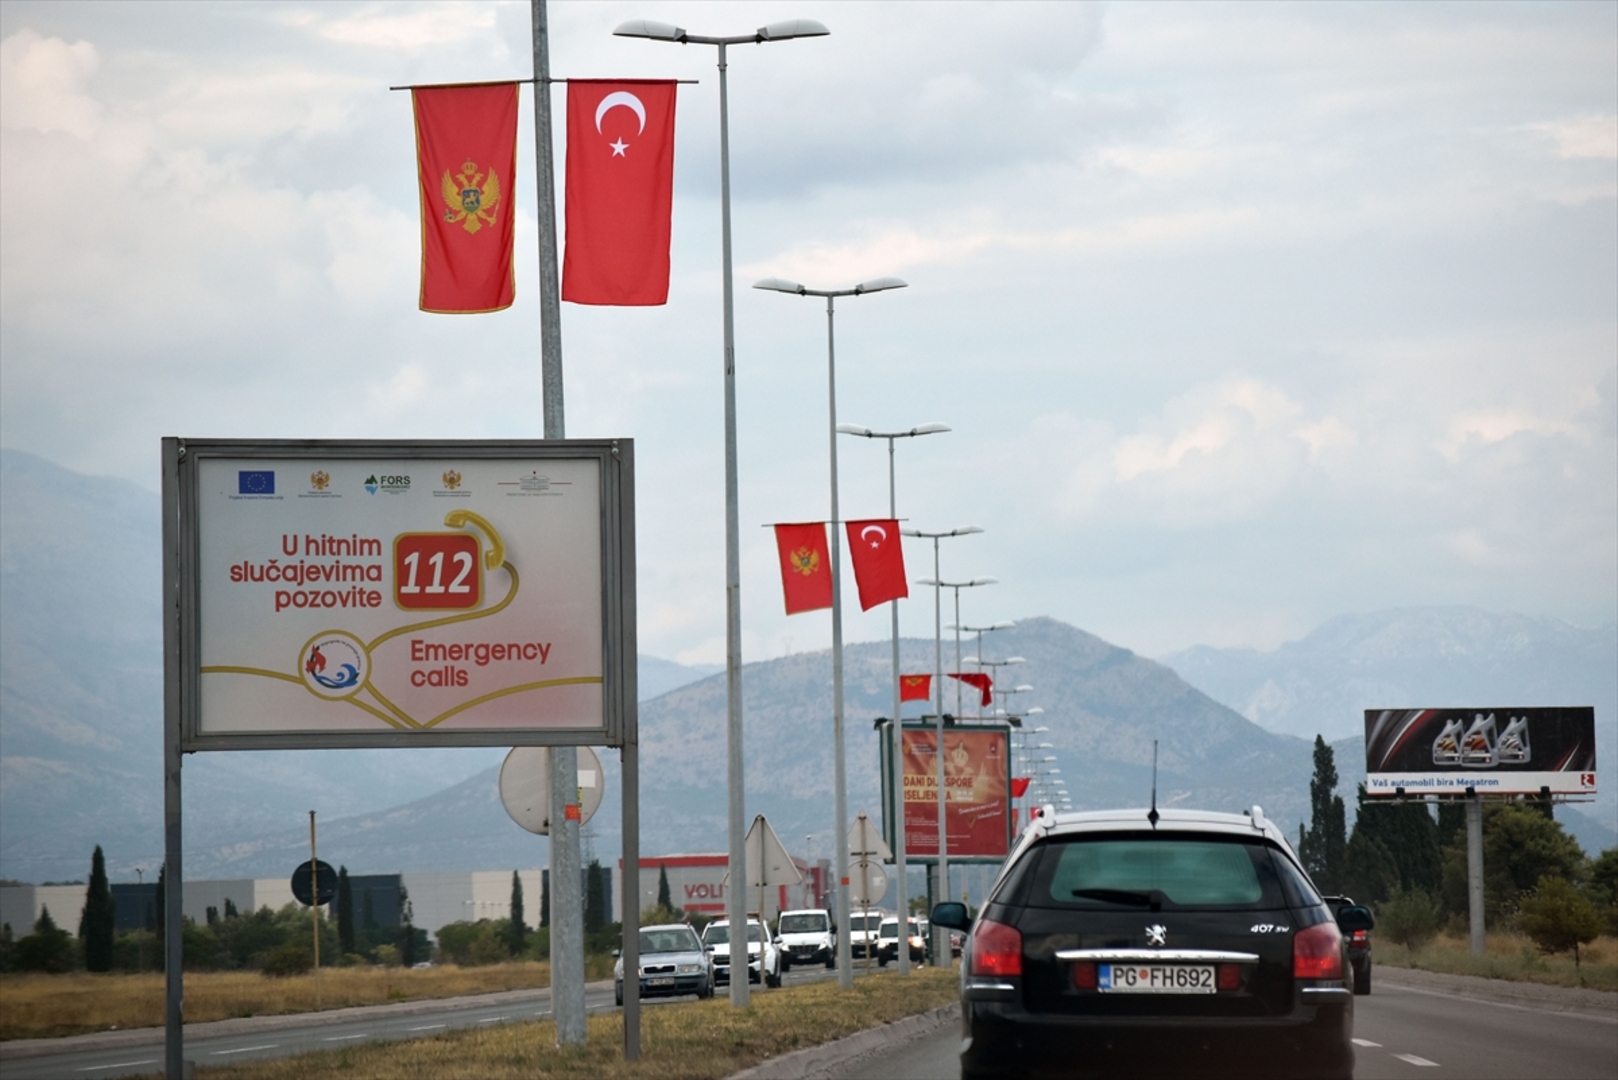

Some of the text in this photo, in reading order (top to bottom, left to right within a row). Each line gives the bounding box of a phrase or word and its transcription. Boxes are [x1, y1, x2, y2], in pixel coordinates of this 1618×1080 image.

[380, 476, 411, 485] FORS
[282, 534, 382, 556] U hitnim
[230, 559, 382, 586] slučajevima
[400, 551, 473, 593] 112
[275, 586, 382, 612] pozovite
[410, 639, 551, 666] Emergency
[410, 666, 469, 687] calls
[904, 776, 925, 787] DANI
[1372, 778, 1499, 787] Vaš automobil bira Megatron
[684, 883, 723, 899] VOLI
[1250, 924, 1274, 933] 407
[1113, 967, 1137, 987] PG
[1151, 967, 1213, 987] FH692
